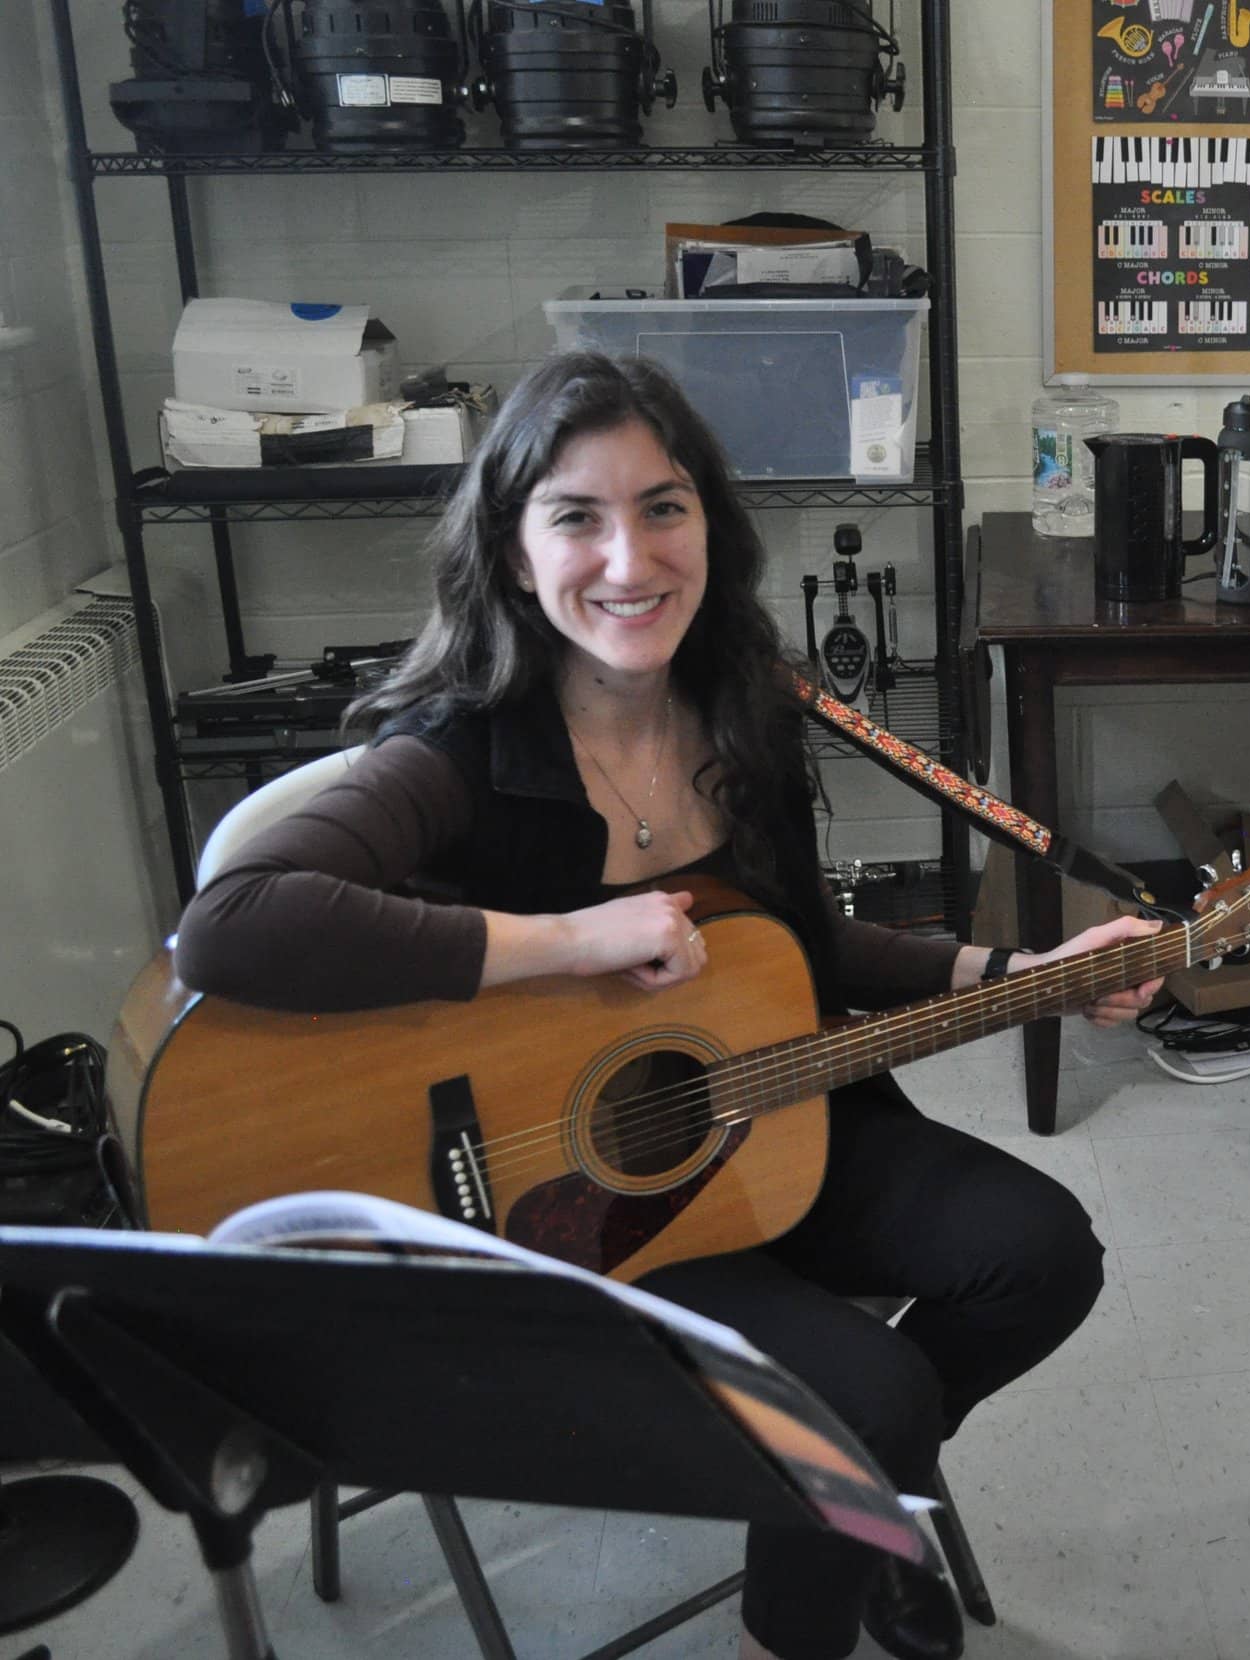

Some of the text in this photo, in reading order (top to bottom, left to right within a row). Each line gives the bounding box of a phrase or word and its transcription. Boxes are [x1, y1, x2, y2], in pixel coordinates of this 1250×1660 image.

[1218, 51, 1239, 59] PIANO
[1141, 190, 1206, 204] SCALES
[1137, 271, 1208, 285] CHORDS
